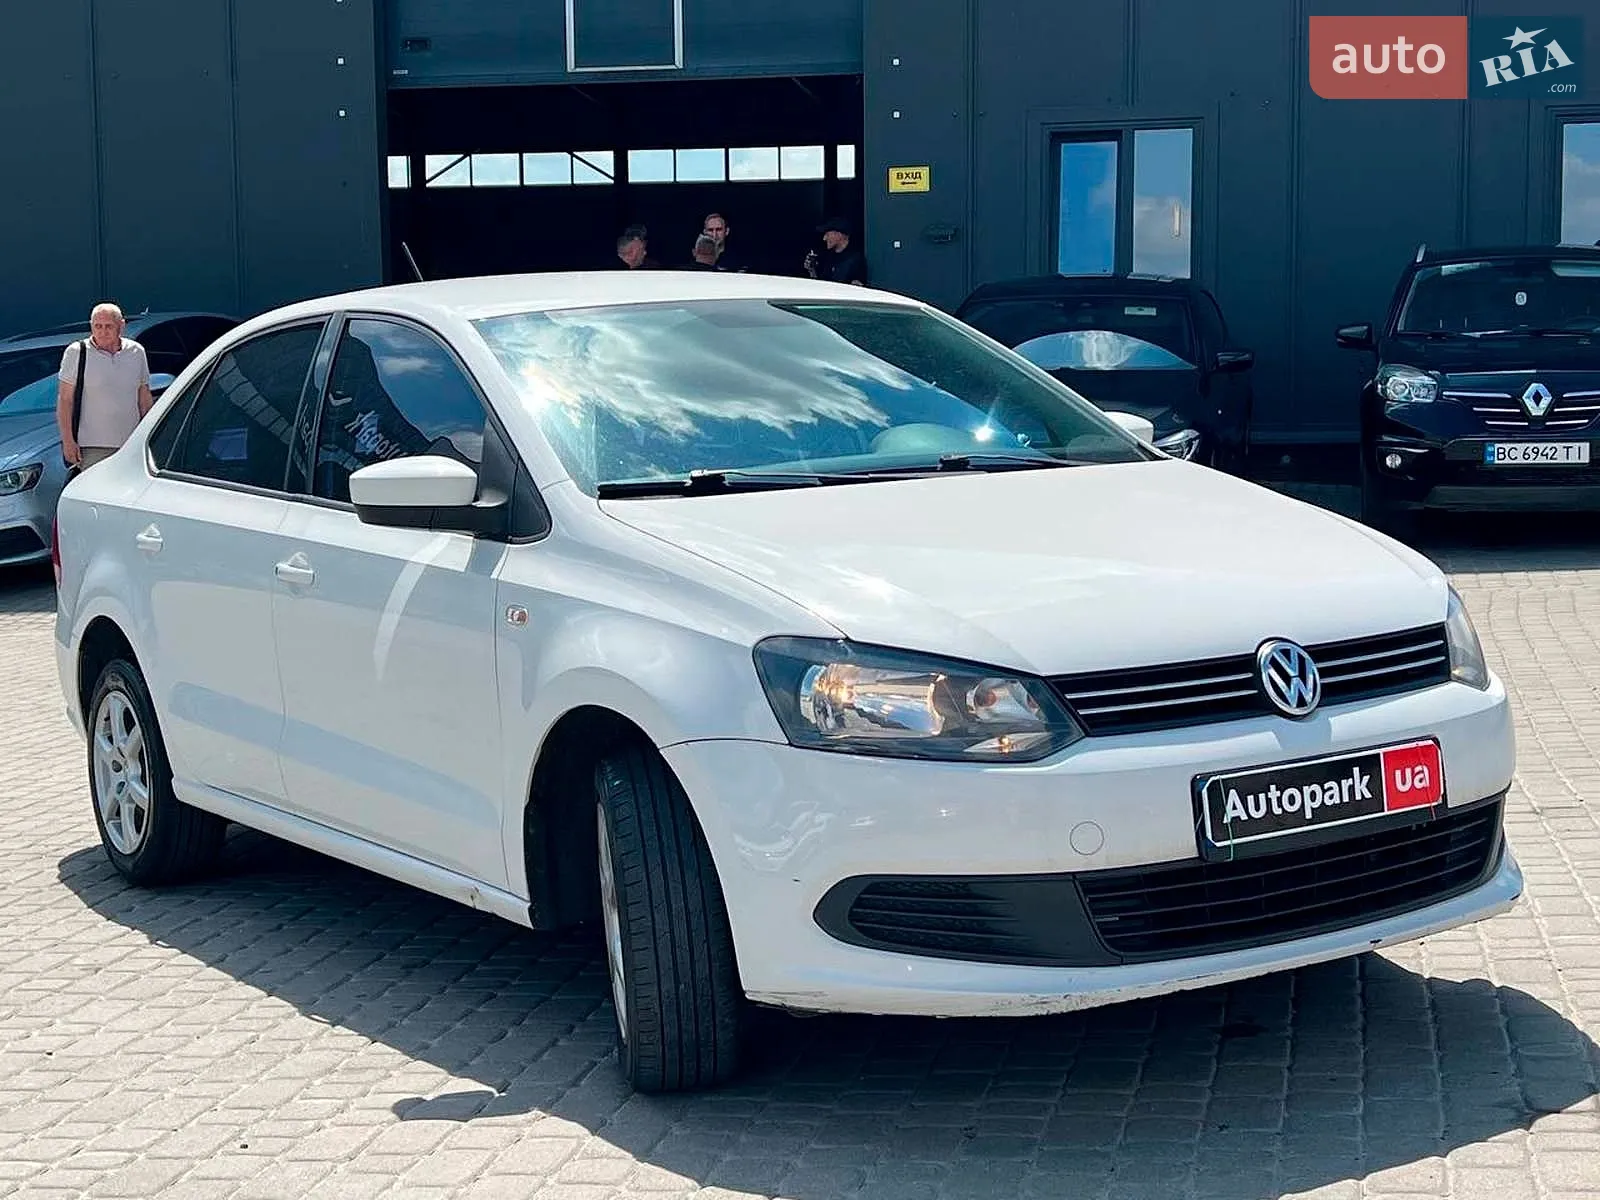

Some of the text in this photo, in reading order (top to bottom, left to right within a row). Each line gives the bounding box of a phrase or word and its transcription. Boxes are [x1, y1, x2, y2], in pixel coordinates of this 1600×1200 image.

[1496, 446, 1518, 461] BC
[1522, 446, 1558, 461] 6942
[1222, 763, 1431, 825] Autopark ua
